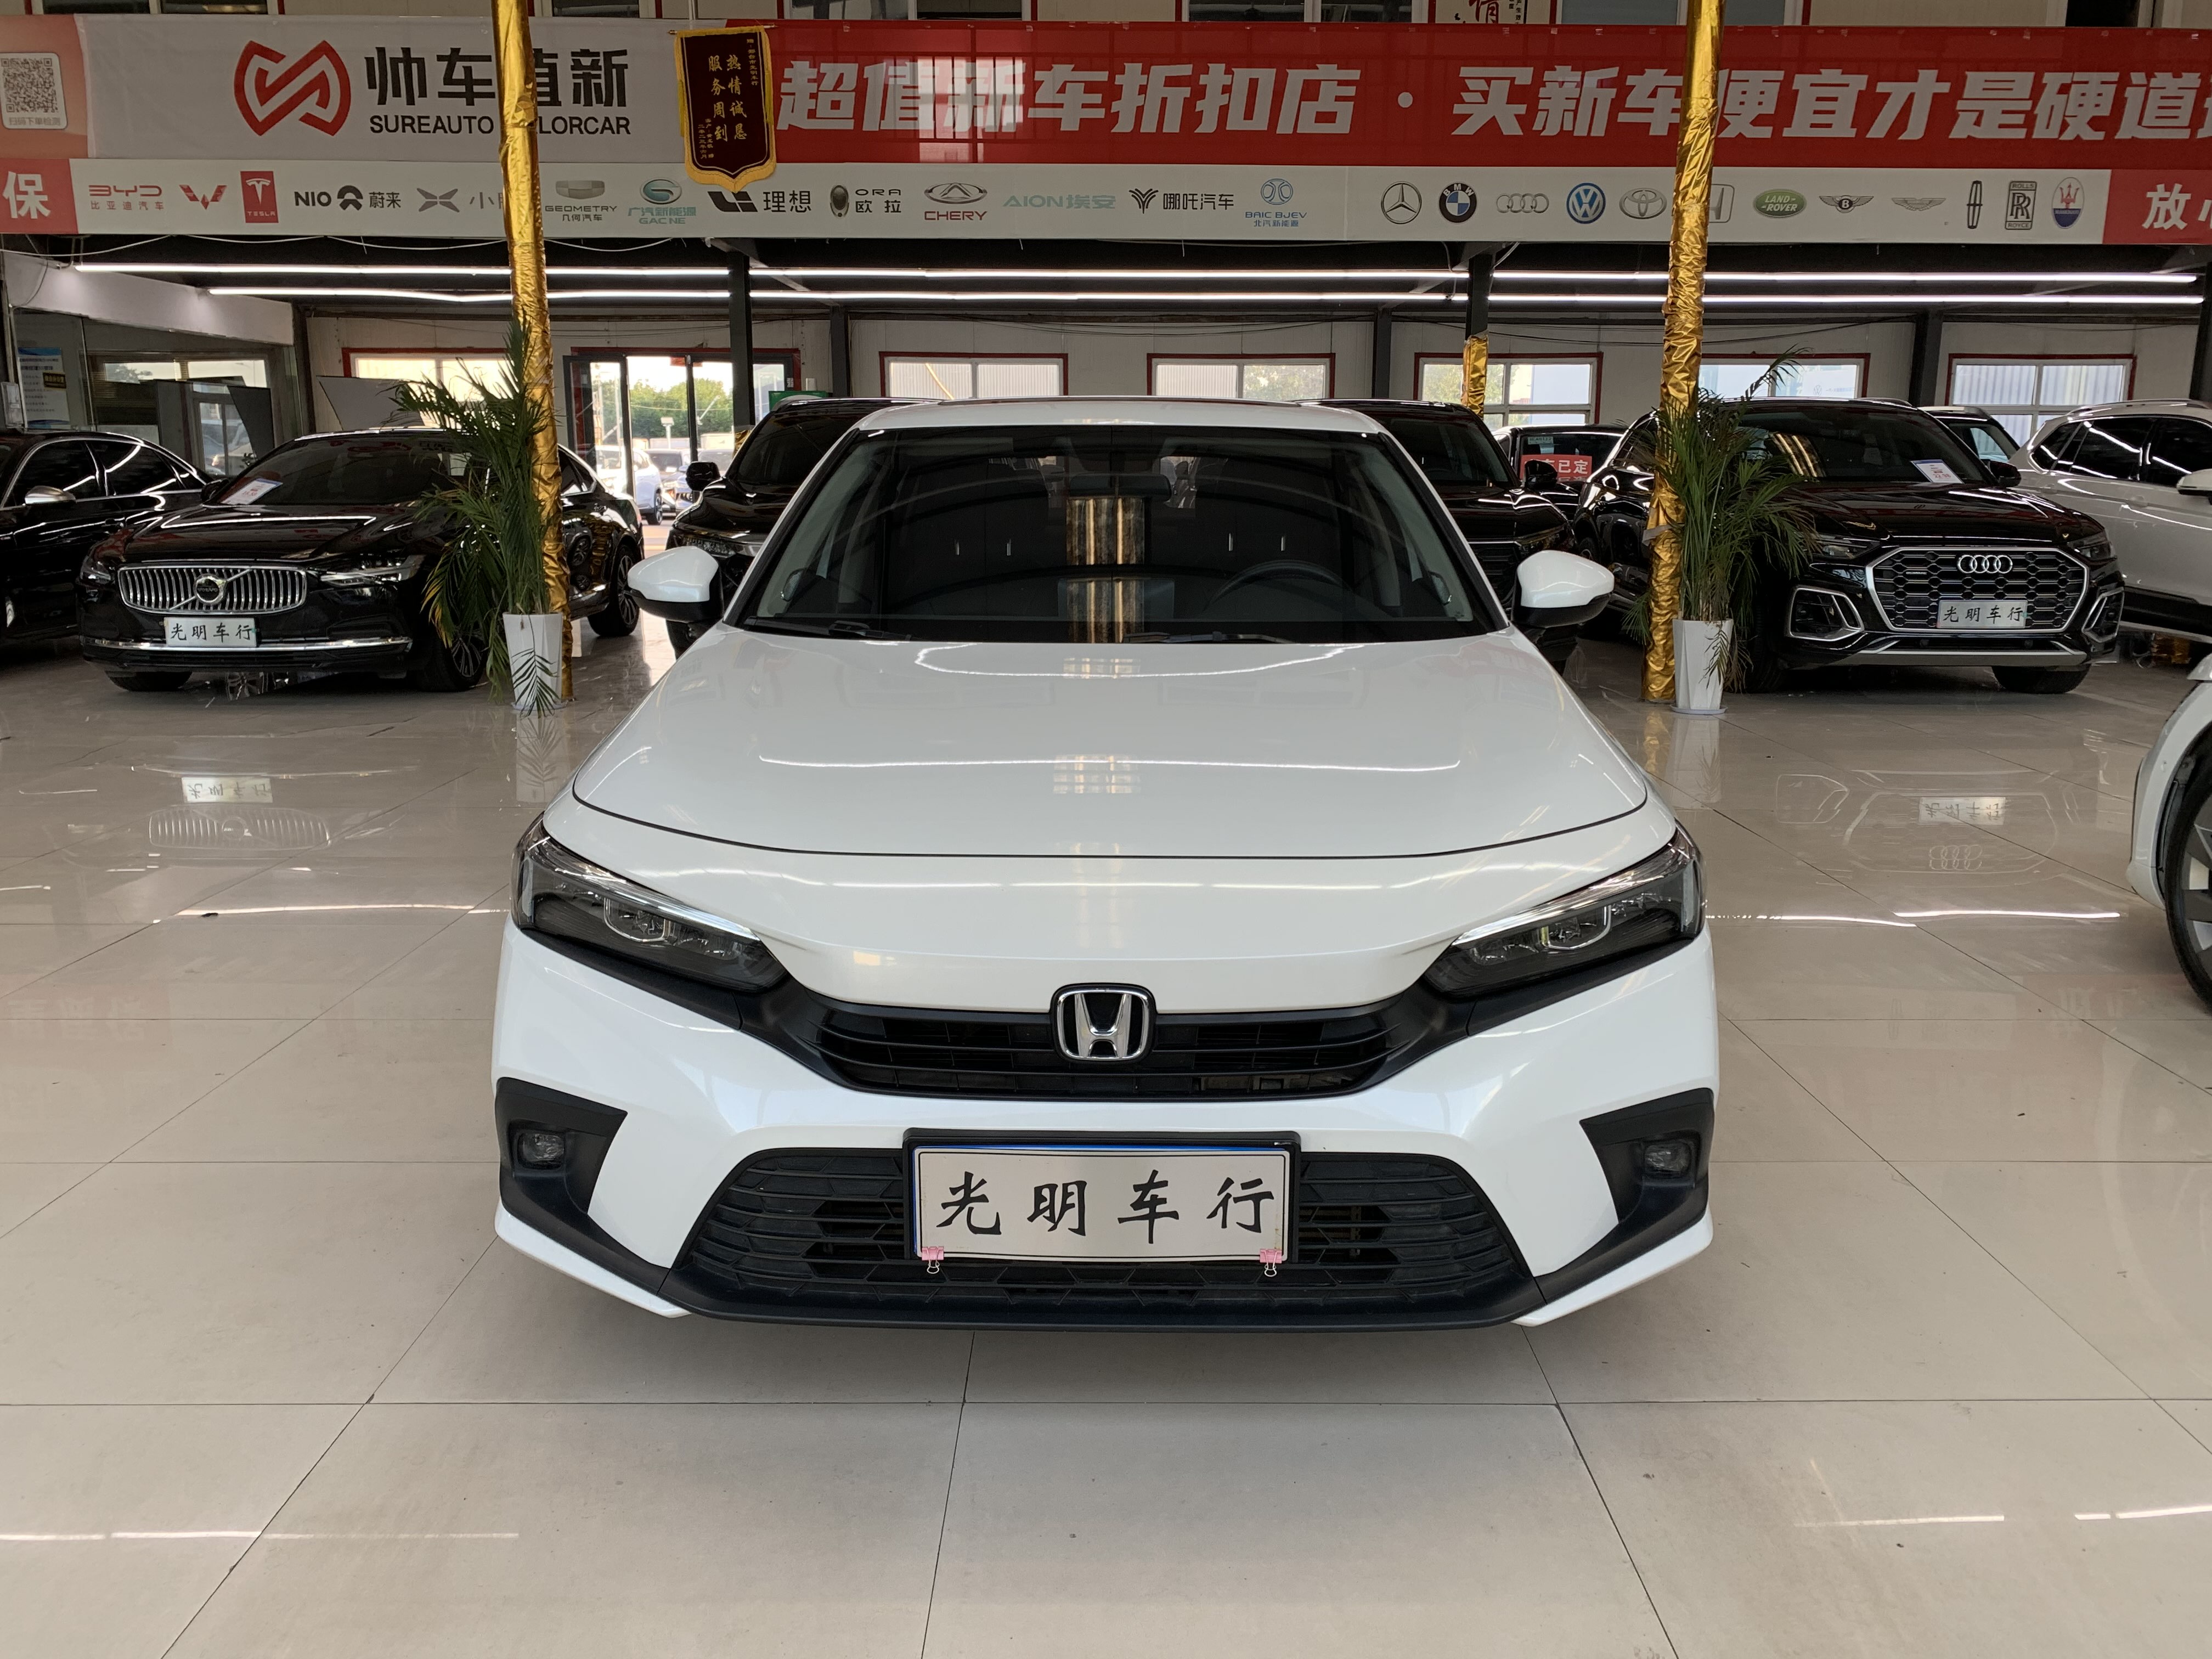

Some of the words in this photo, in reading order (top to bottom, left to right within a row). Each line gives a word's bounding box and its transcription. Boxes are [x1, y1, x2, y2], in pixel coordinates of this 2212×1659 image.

[708, 55, 728, 142] 服务周到
[726, 55, 748, 140] 热情诚恳
[776, 60, 1361, 134] 超值新车折扣店
[369, 115, 494, 134] SUREAUTO
[2, 171, 52, 219] 保
[294, 191, 332, 206] NIO
[1443, 183, 1474, 197] BMW
[90, 201, 164, 210] 比亚迪汽车
[369, 191, 402, 209] 蔚来
[763, 190, 812, 213] 理想
[855, 200, 902, 213] 欧拉
[1002, 195, 1063, 207] AION
[1065, 194, 1116, 209] 埃安
[1163, 193, 1234, 210] 哪吒汽车
[628, 207, 697, 217] 广汽新能源
[924, 211, 988, 221] CHERY
[1943, 605, 2023, 624] 光明车行
[171, 622, 252, 643] 光明车行
[936, 1169, 1275, 1244] 光明车行
